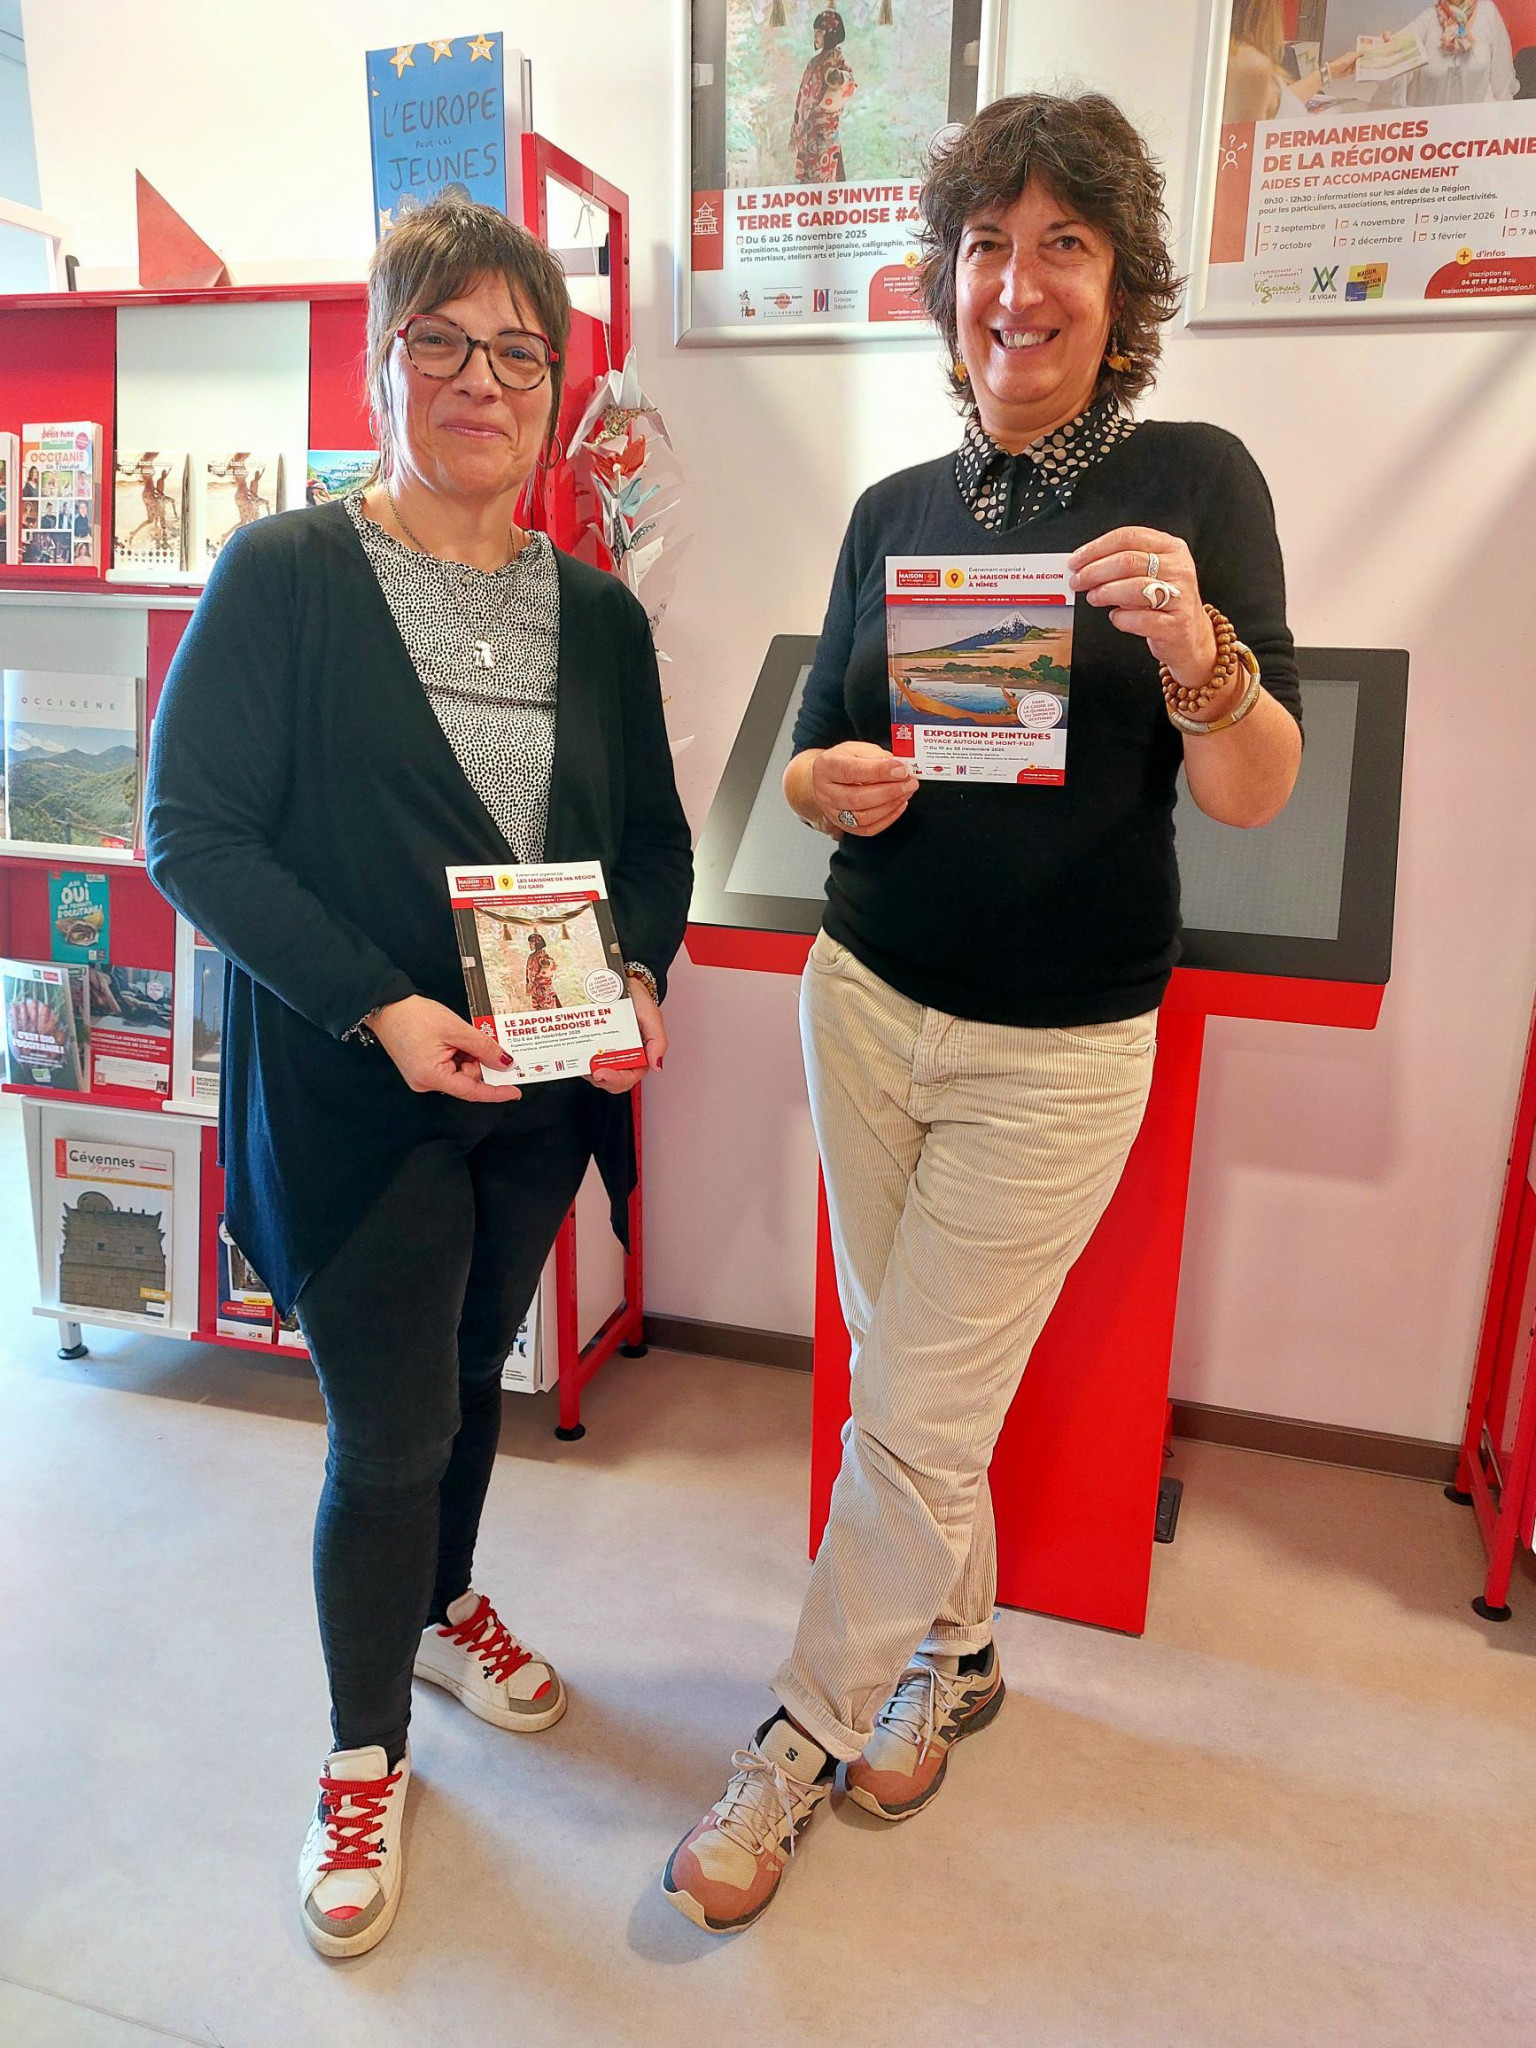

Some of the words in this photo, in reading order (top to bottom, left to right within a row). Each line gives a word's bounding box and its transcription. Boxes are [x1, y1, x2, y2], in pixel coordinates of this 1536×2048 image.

[383, 87, 497, 138] L'EUROPE
[1265, 120, 1428, 149] PERMANENCES
[1263, 155, 1292, 172] DE
[1298, 152, 1325, 170] LA
[1331, 144, 1414, 168] RÉGION
[1420, 137, 1536, 161] OCCITANIE
[388, 142, 498, 191] JEUNES
[1260, 177, 1300, 190] AIDES
[1304, 176, 1319, 187] ET
[1322, 166, 1459, 186] ACCOMPAGNEMENT
[737, 195, 757, 210] LE
[762, 190, 822, 209] JAPON
[828, 186, 903, 205] S'INVITE
[909, 186, 920, 201] E
[1264, 197, 1284, 205] 8h30
[1290, 195, 1312, 203] 12h30
[1397, 187, 1418, 195] aides
[1420, 186, 1431, 194] de
[1441, 184, 1470, 194] Région
[1258, 208, 1276, 216] pour
[1390, 197, 1436, 206] entreprises
[737, 213, 792, 230] TERRE
[797, 207, 890, 227] GARDOISE
[895, 206, 920, 222] #4
[1360, 218, 1406, 227] novembre
[1440, 213, 1471, 224] janvier
[1473, 211, 1495, 220] 2026
[1281, 223, 1326, 233] septembre
[1438, 231, 1467, 240] février
[746, 236, 758, 244] Du
[761, 235, 767, 243] 6
[782, 233, 793, 242] 26
[795, 231, 843, 242] novembre
[844, 229, 867, 239] 2025
[1358, 235, 1403, 245] décembre
[782, 244, 824, 253] gastronomie
[1279, 241, 1312, 250] octobre
[836, 250, 851, 259] jeux
[1476, 250, 1506, 258] d'infos
[31, 452, 84, 463] OCCITANIE
[1036, 572, 1064, 580] RÉGION
[923, 730, 988, 738] EXPOSITION
[991, 731, 1051, 740] PEINTURES
[504, 1020, 516, 1028] LE
[519, 1016, 553, 1027] JAPON
[555, 1010, 595, 1021] S'INVITE
[598, 1008, 612, 1016] EN
[506, 1027, 538, 1037] TERRE
[540, 1020, 591, 1033] GARDOISE
[594, 1017, 607, 1025] #4
[69, 1150, 135, 1168] Cévennes
